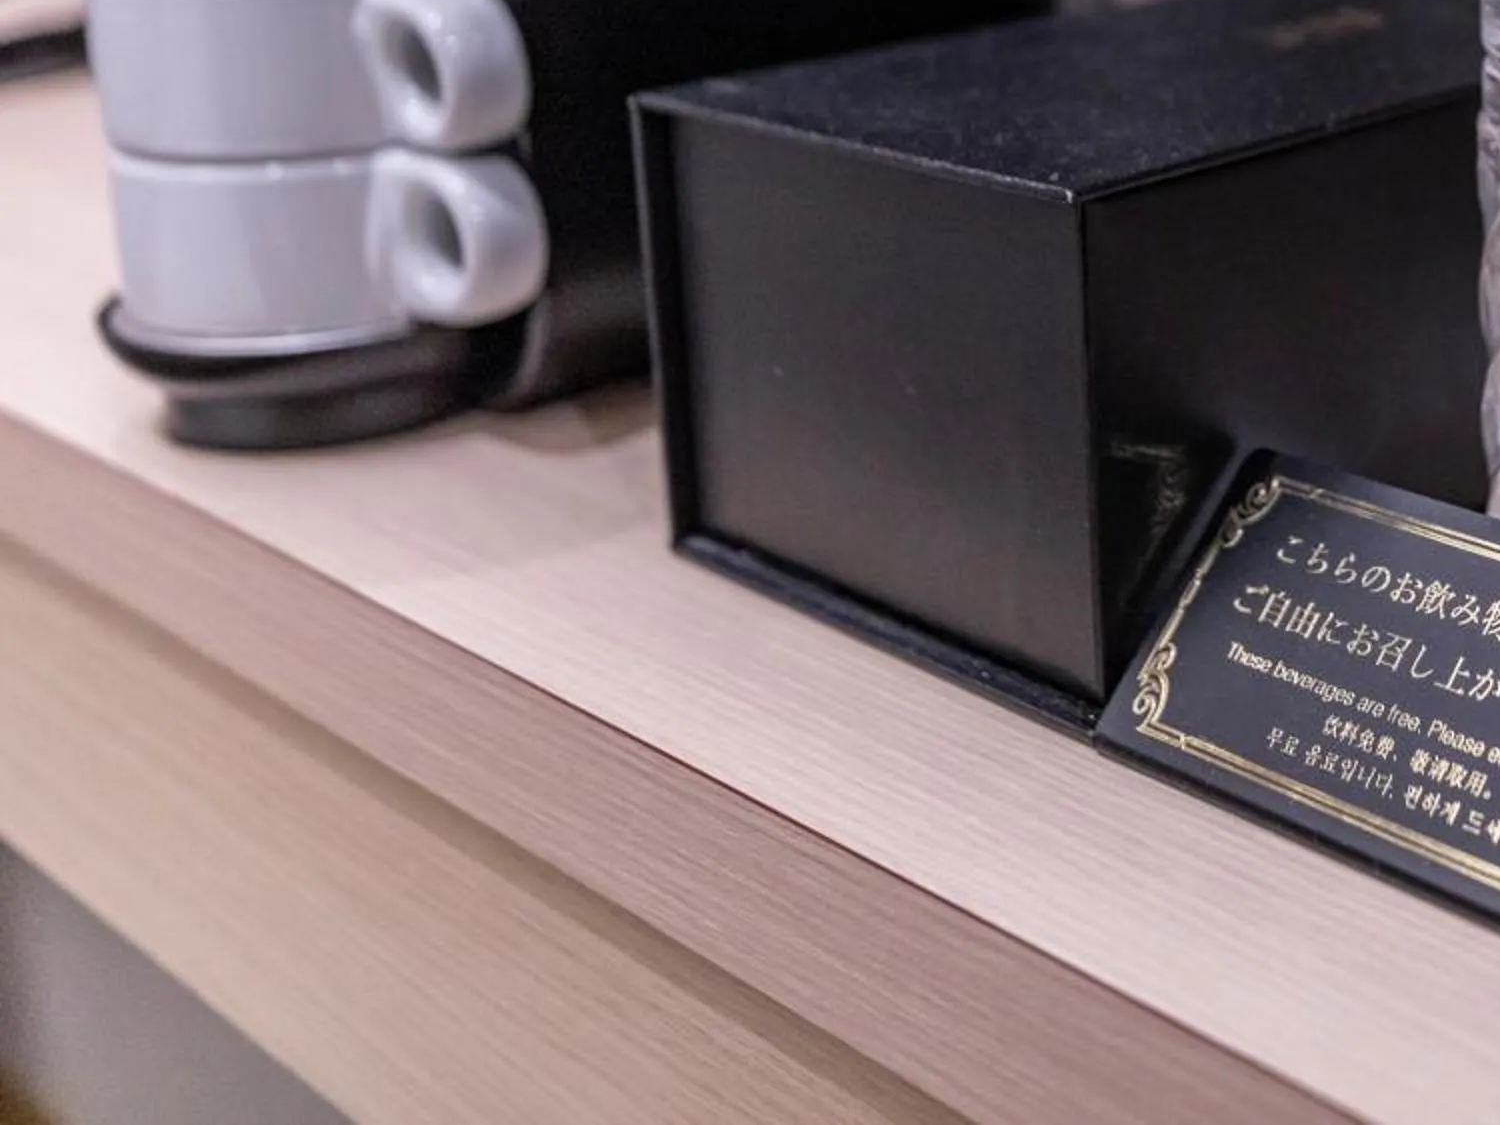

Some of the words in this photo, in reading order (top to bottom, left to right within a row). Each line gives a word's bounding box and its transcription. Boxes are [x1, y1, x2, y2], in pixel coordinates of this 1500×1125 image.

[1226, 641, 1273, 673] These
[1272, 659, 1356, 706] beverages
[1357, 697, 1385, 718] are
[1387, 704, 1421, 735] free.
[1427, 718, 1485, 758] Please
[1266, 726, 1300, 758] 무료
[1404, 784, 1462, 826] 편하게
